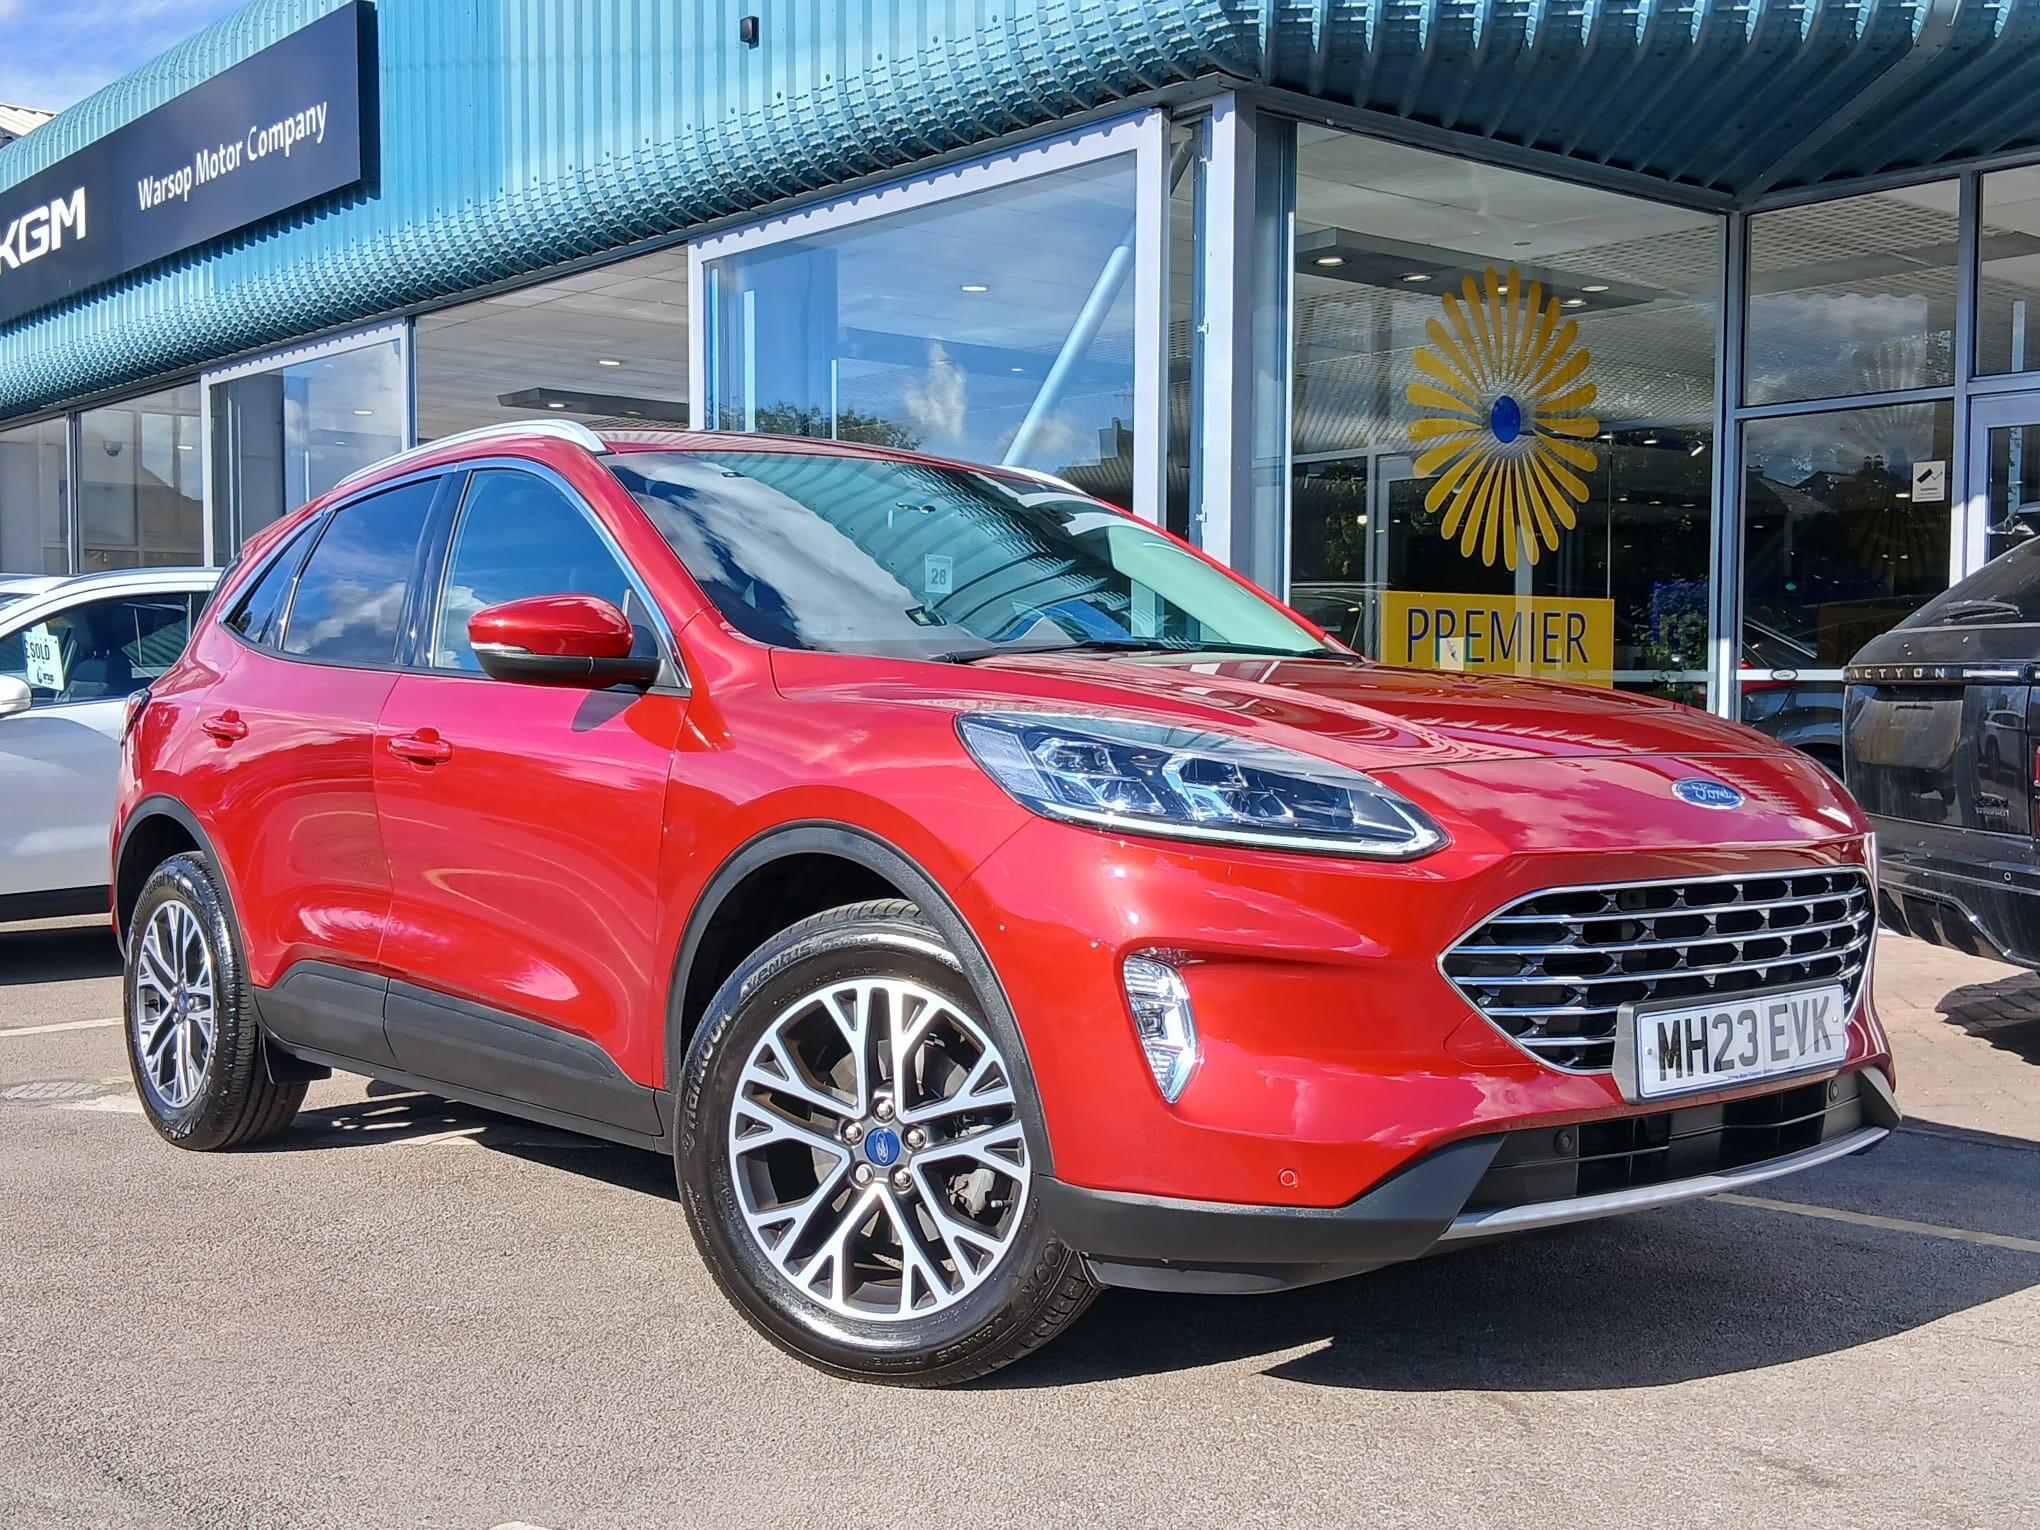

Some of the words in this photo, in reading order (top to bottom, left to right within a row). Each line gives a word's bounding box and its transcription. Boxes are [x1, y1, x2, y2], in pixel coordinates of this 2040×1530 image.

[138, 164, 192, 211] Warsop
[195, 140, 243, 186] Motor
[247, 101, 328, 161] Company
[0, 186, 86, 275] KGM
[931, 568, 946, 585] 28
[1407, 607, 1589, 663] PREMIER
[1852, 667, 1945, 679] ACTYON
[1657, 1008, 1758, 1082] MH23
[1768, 995, 1832, 1062] EVK
